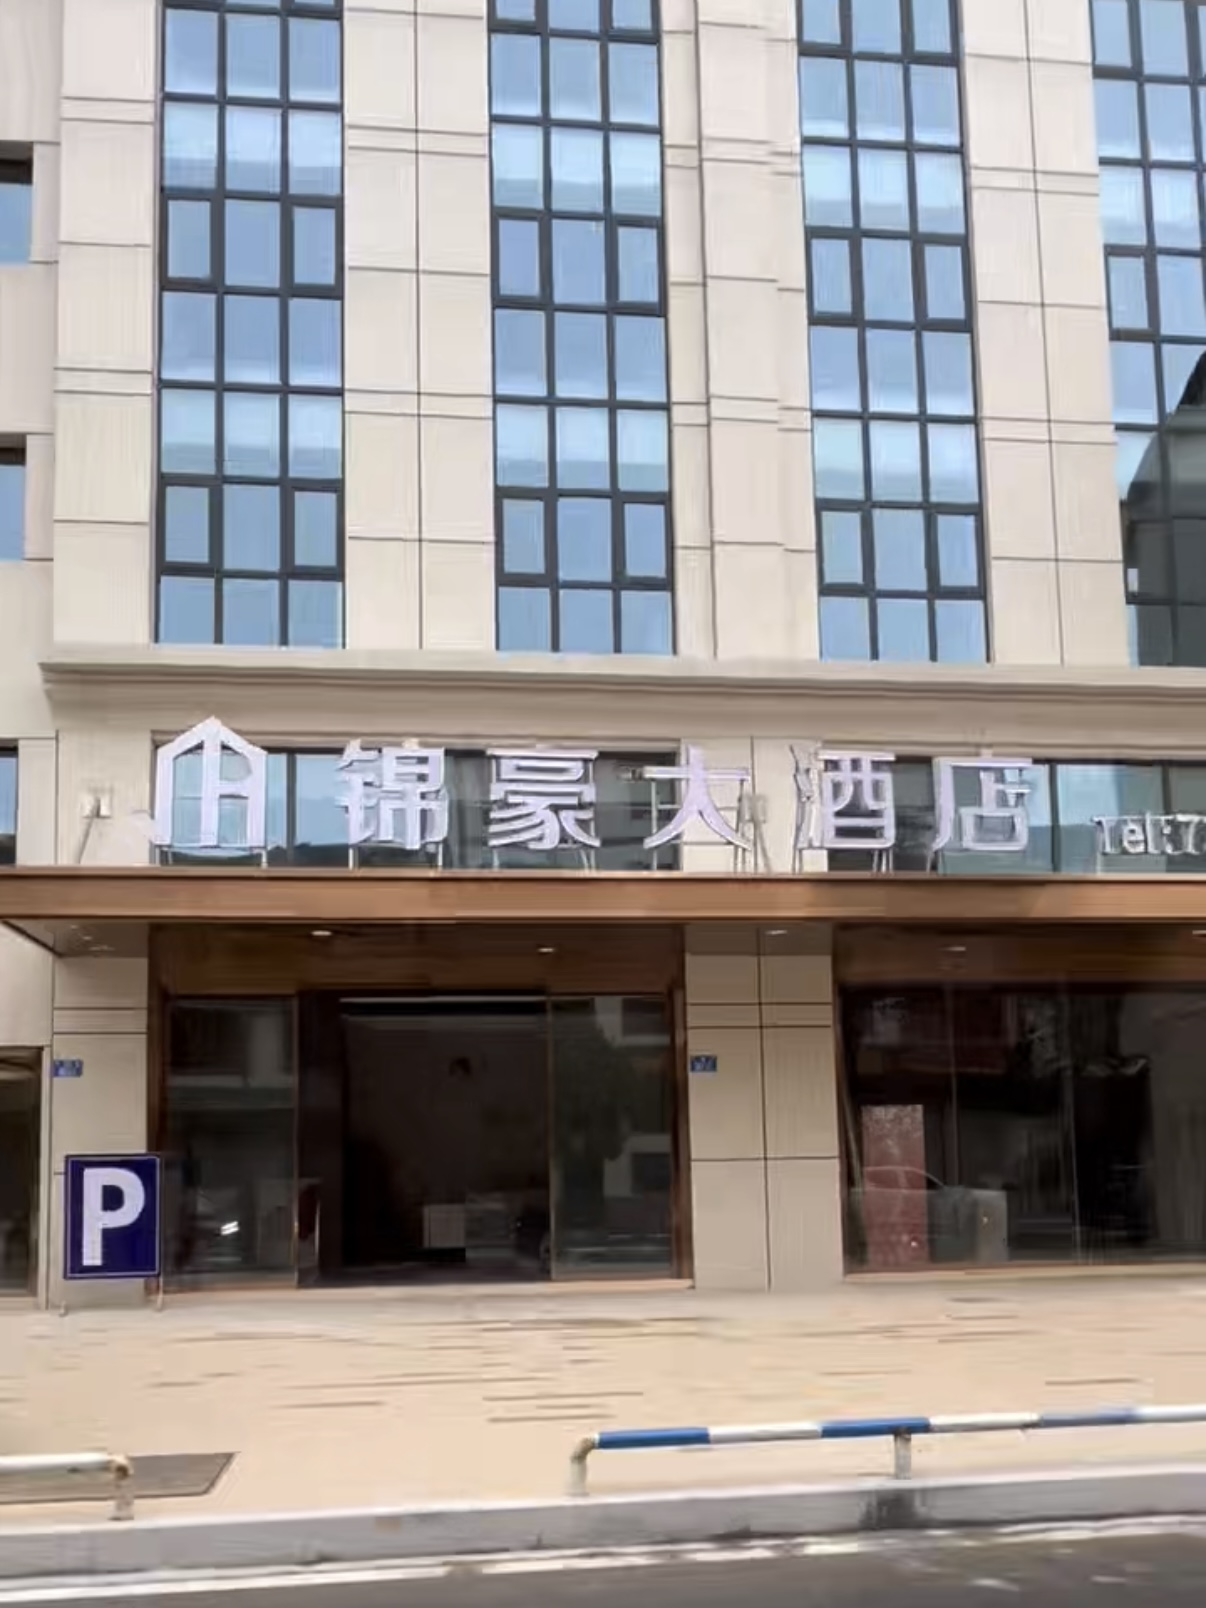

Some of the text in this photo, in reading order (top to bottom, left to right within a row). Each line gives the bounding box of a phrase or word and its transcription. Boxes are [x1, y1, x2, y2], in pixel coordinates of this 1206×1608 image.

[337, 739, 1033, 851] 锦豪大酒店
[1091, 812, 1206, 855] Tel:7
[82, 1167, 145, 1266] P
